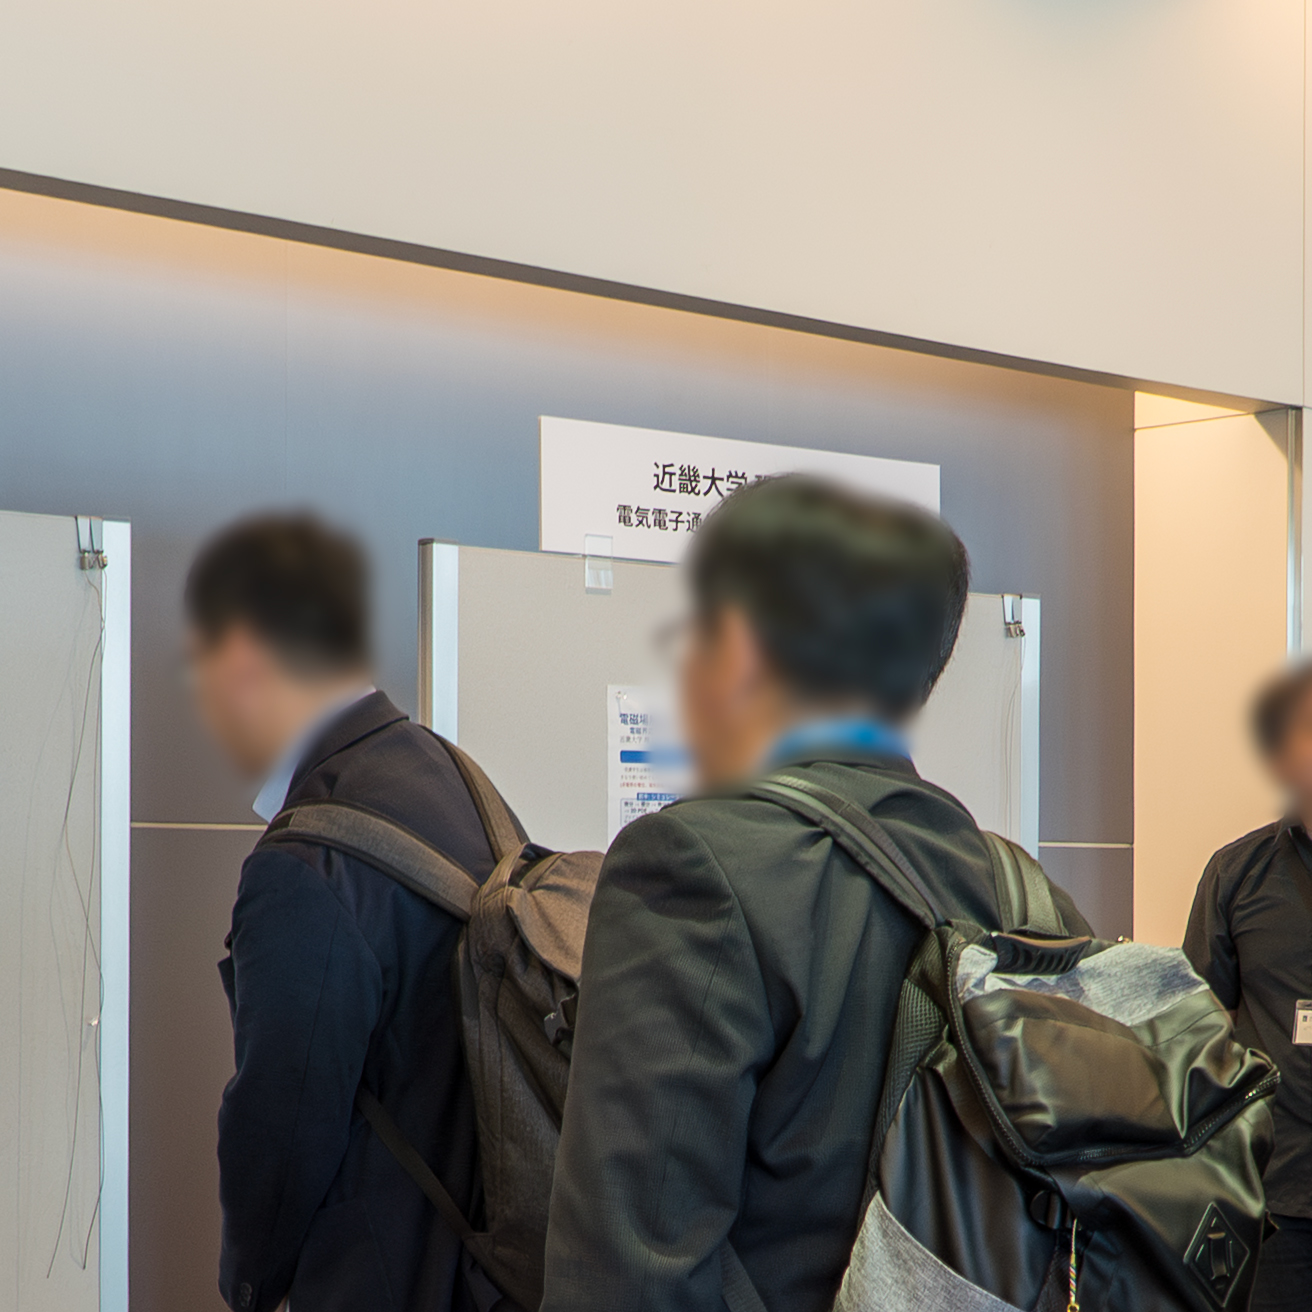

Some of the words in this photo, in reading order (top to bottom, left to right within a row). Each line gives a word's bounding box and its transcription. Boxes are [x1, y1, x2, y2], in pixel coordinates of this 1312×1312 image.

[653, 462, 748, 499] 近畿大学
[616, 504, 703, 533] 電気電子通
